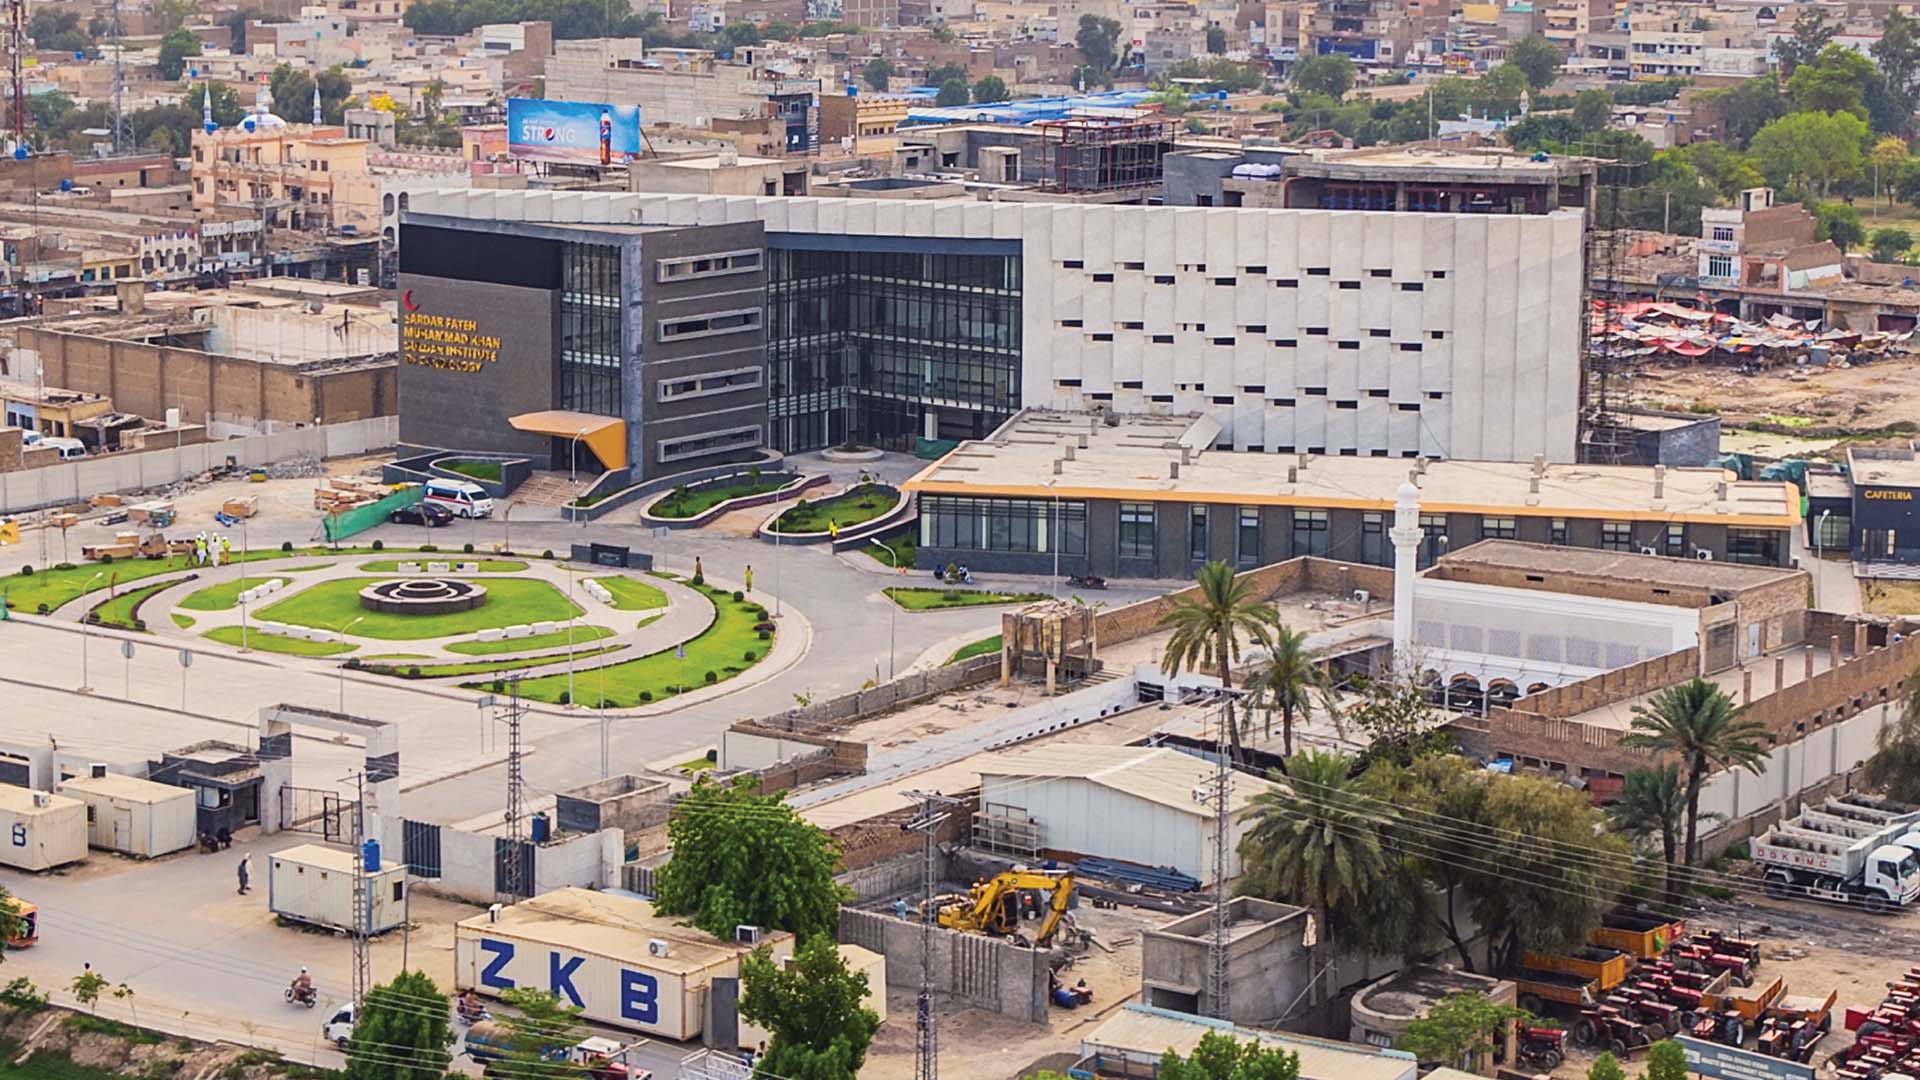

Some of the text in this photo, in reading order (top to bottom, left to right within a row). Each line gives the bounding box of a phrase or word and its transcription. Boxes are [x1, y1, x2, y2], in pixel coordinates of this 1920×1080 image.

[522, 125, 577, 144] STRONG
[403, 313, 478, 332] SARDAR FATEH
[403, 327, 502, 350] MUHAMMAD KHAN
[419, 355, 483, 373] CDOLOGY
[445, 346, 498, 363] INSTITUTE
[1864, 490, 1913, 500] CAFETERIA
[12, 822, 26, 847] B
